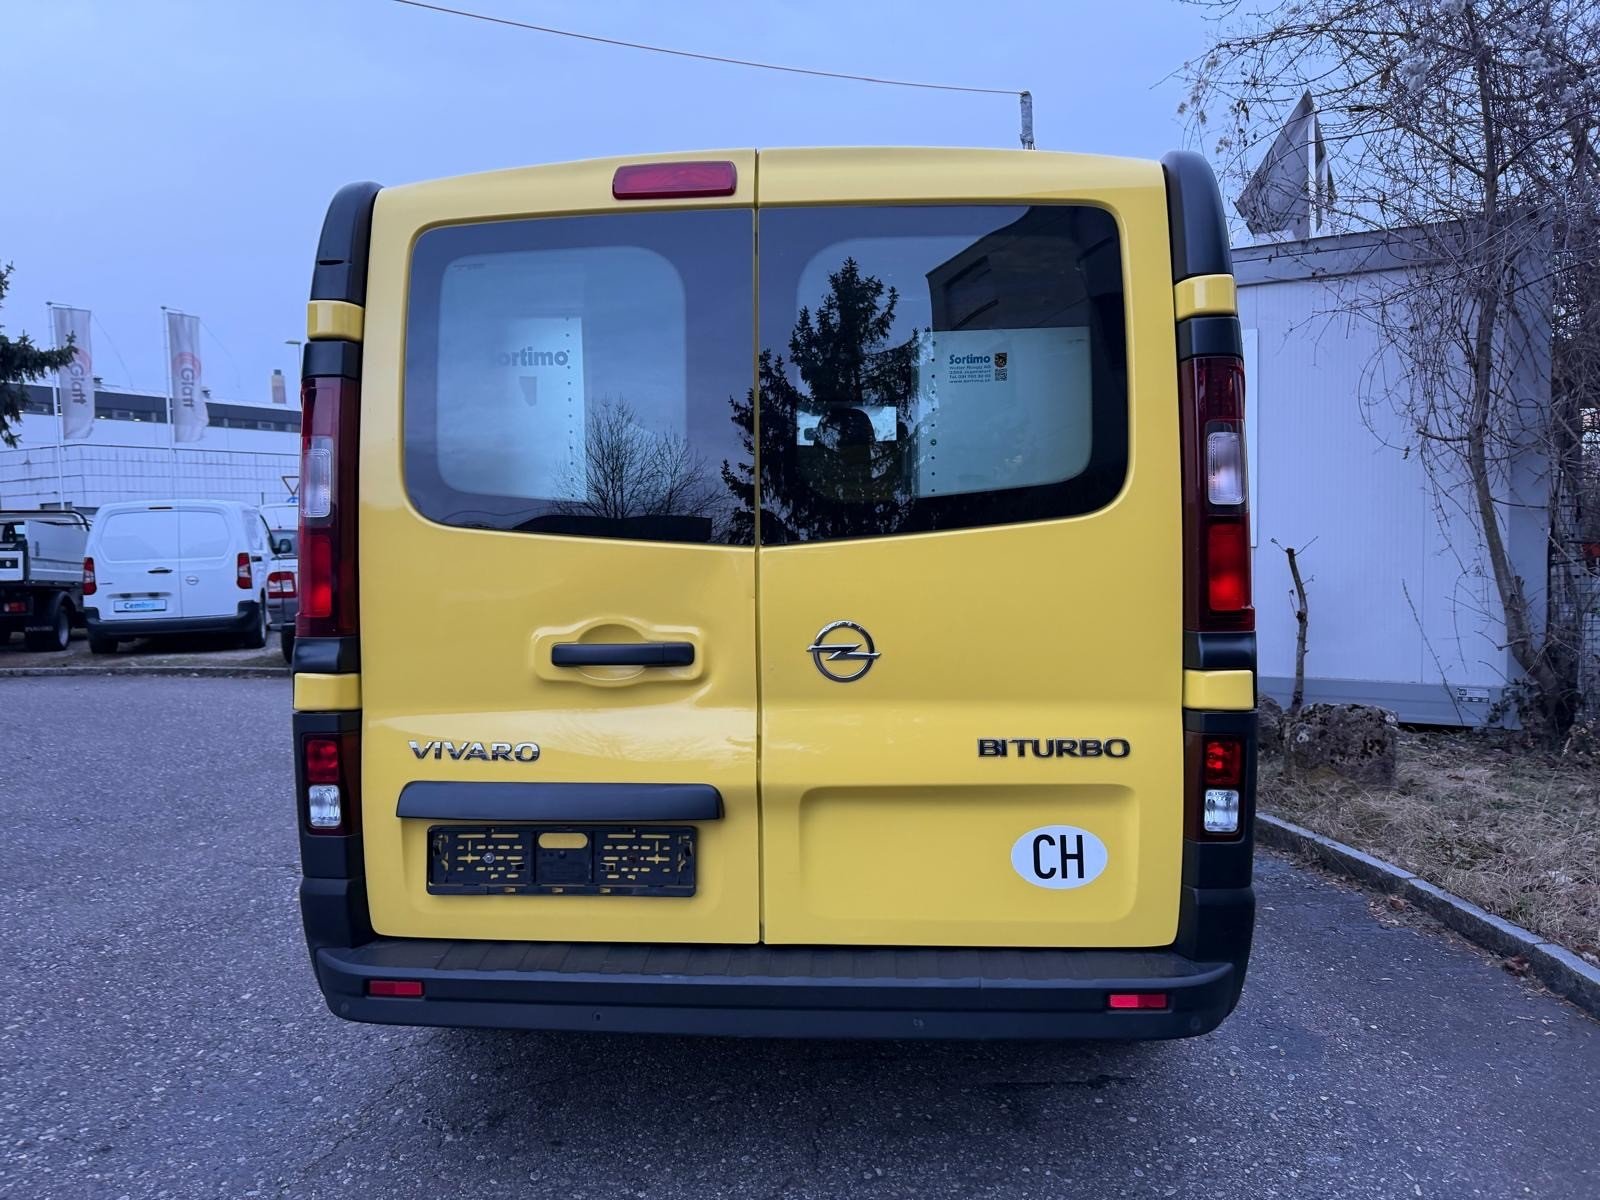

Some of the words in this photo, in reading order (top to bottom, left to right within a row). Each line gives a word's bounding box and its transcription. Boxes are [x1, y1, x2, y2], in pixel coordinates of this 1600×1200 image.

[489, 346, 569, 366] ortimo
[949, 353, 991, 365] Sortimo
[180, 367, 195, 408] Glatt
[408, 740, 540, 762] VIVARO
[1032, 834, 1085, 880] CH
